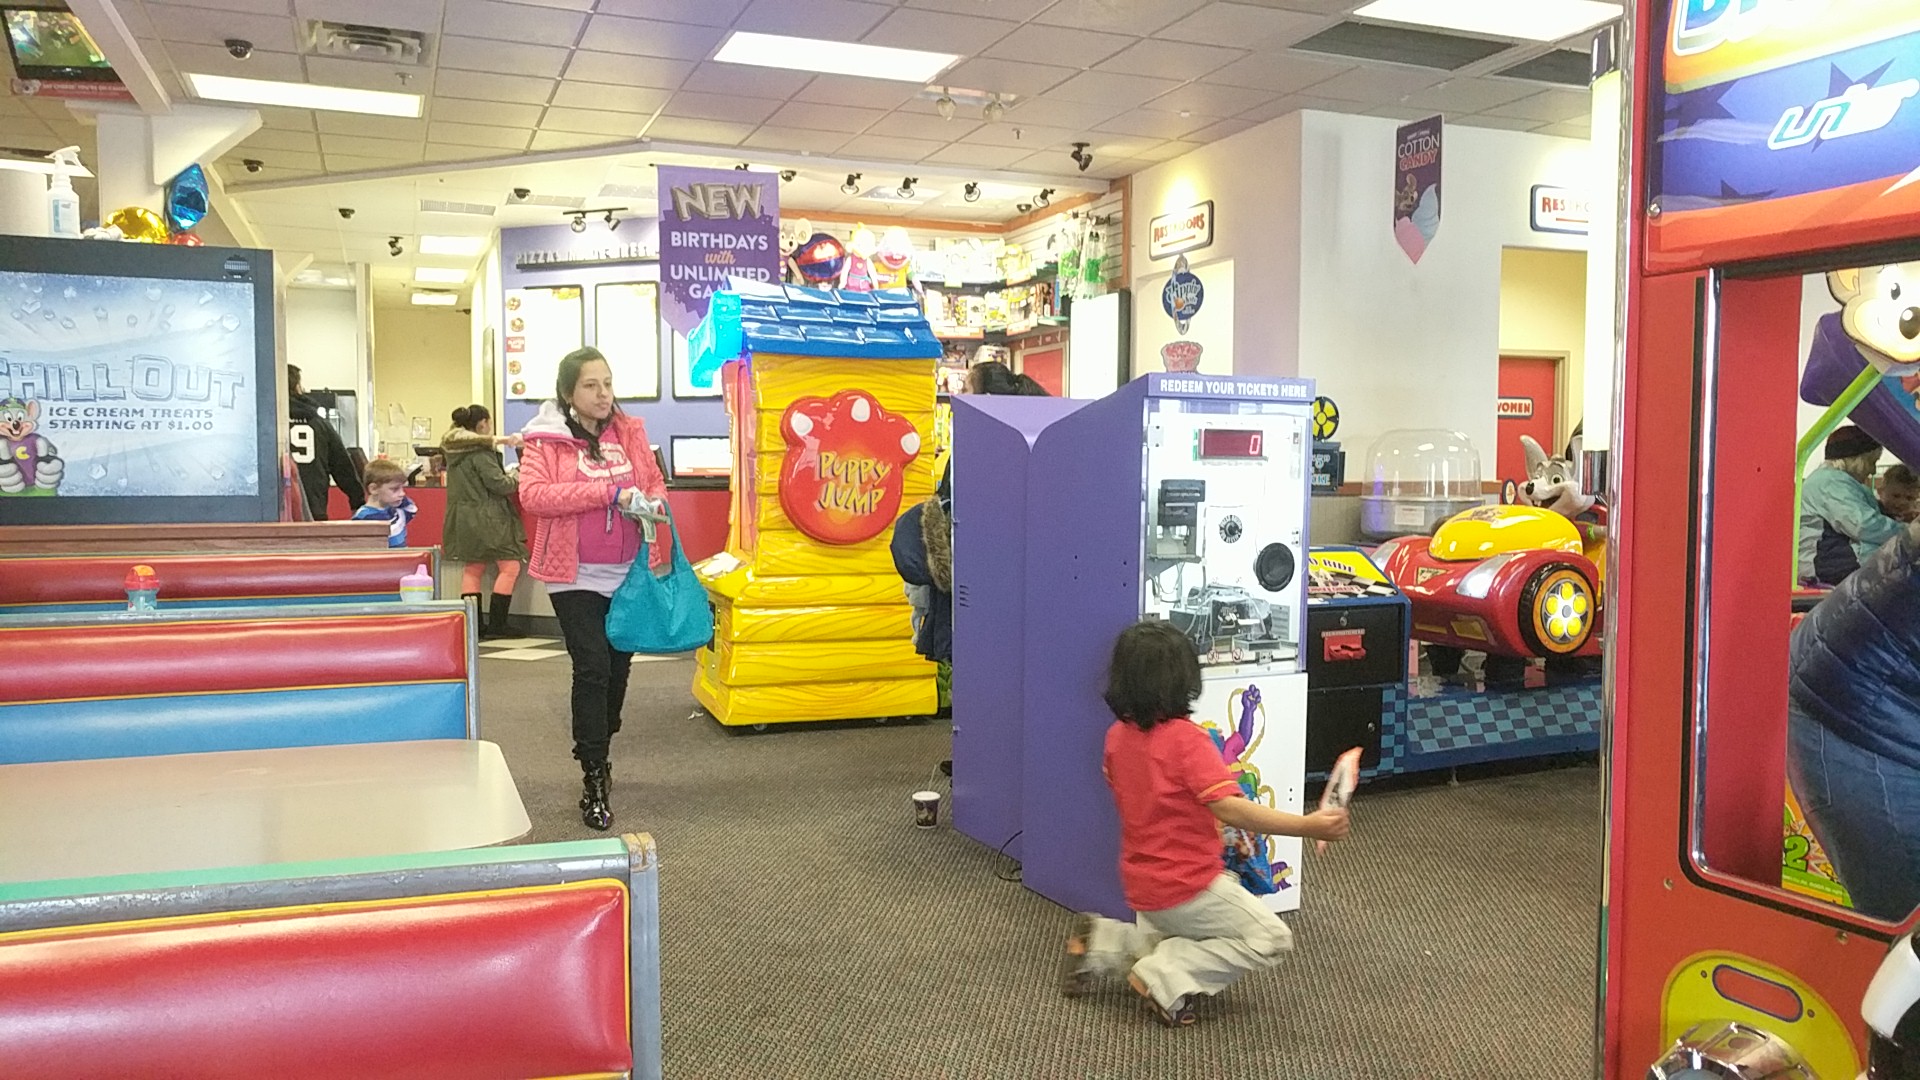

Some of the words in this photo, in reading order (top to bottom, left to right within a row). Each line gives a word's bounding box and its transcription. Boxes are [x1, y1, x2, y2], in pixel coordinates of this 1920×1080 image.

[1398, 132, 1440, 158] COTTON
[1400, 148, 1437, 171] CANDY
[670, 183, 763, 221] NEW
[671, 231, 769, 251] BIRTHDAYS
[704, 250, 736, 265] with
[670, 264, 771, 283] UNLIMITED
[1160, 379, 1204, 393] REDEEM
[1206, 382, 1235, 394] YOUR
[1236, 383, 1279, 396] TICKETS
[1281, 385, 1307, 397] HERE
[49, 407, 77, 417] ICE
[83, 407, 145, 418] CREAM
[151, 408, 213, 418] TREATS
[49, 419, 136, 430] STARTING
[140, 420, 162, 430] AT
[168, 420, 213, 431] $1.00
[1248, 434, 1261, 455] 0
[817, 481, 886, 516] JUMP
